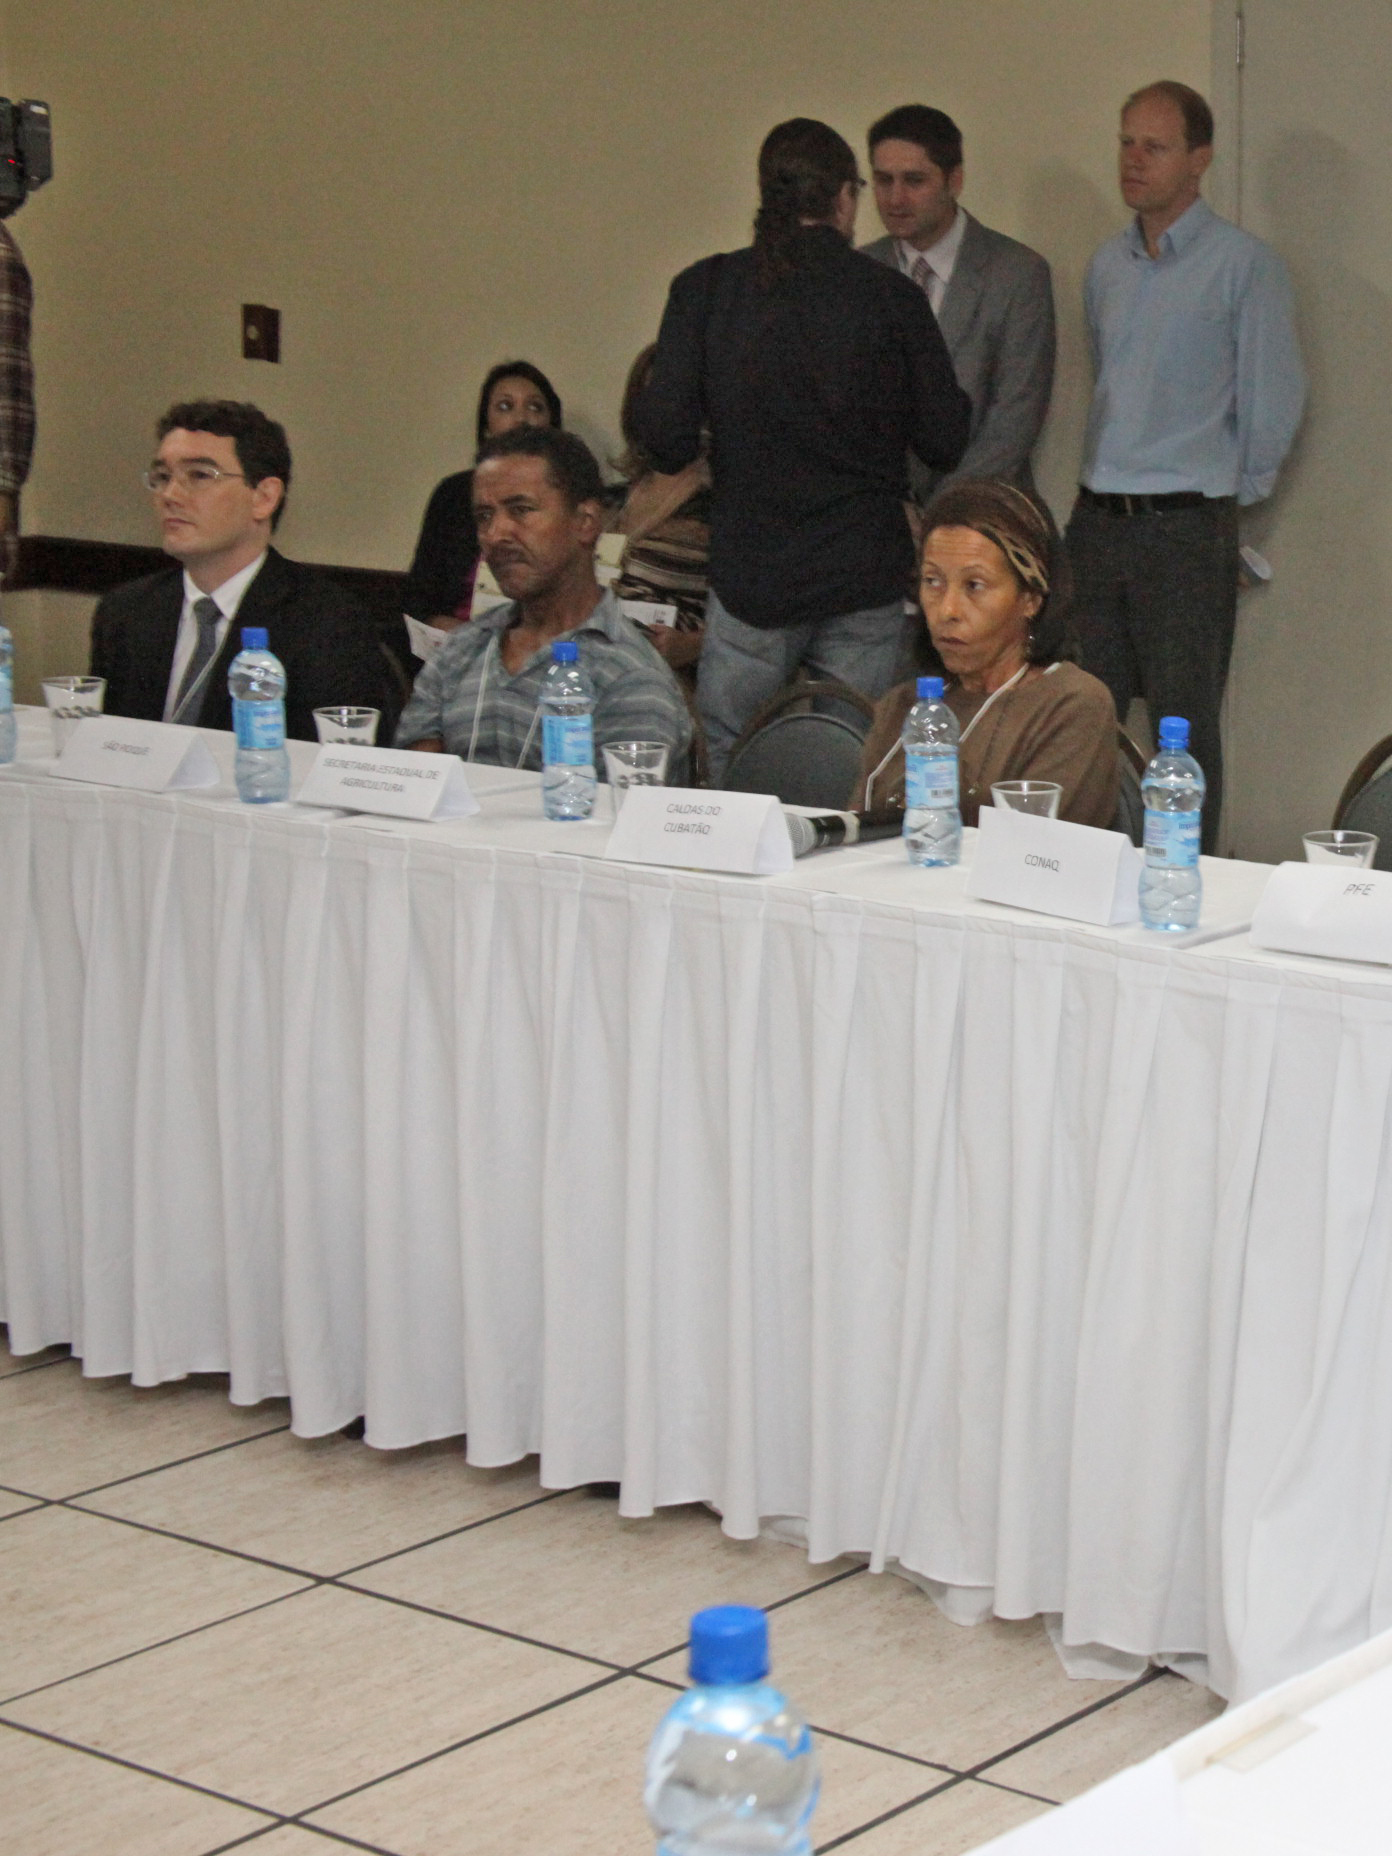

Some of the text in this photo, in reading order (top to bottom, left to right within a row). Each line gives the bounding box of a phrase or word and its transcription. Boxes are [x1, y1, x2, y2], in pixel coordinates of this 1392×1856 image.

[322, 758, 441, 780] SECRETARIA ESTADUAL DE
[340, 777, 404, 792] AGRICULTURA
[666, 803, 721, 816] CALDAS DO
[663, 821, 711, 835] CUBATÃO
[1024, 854, 1060, 872] CONAQ
[1343, 883, 1376, 896] PFE
